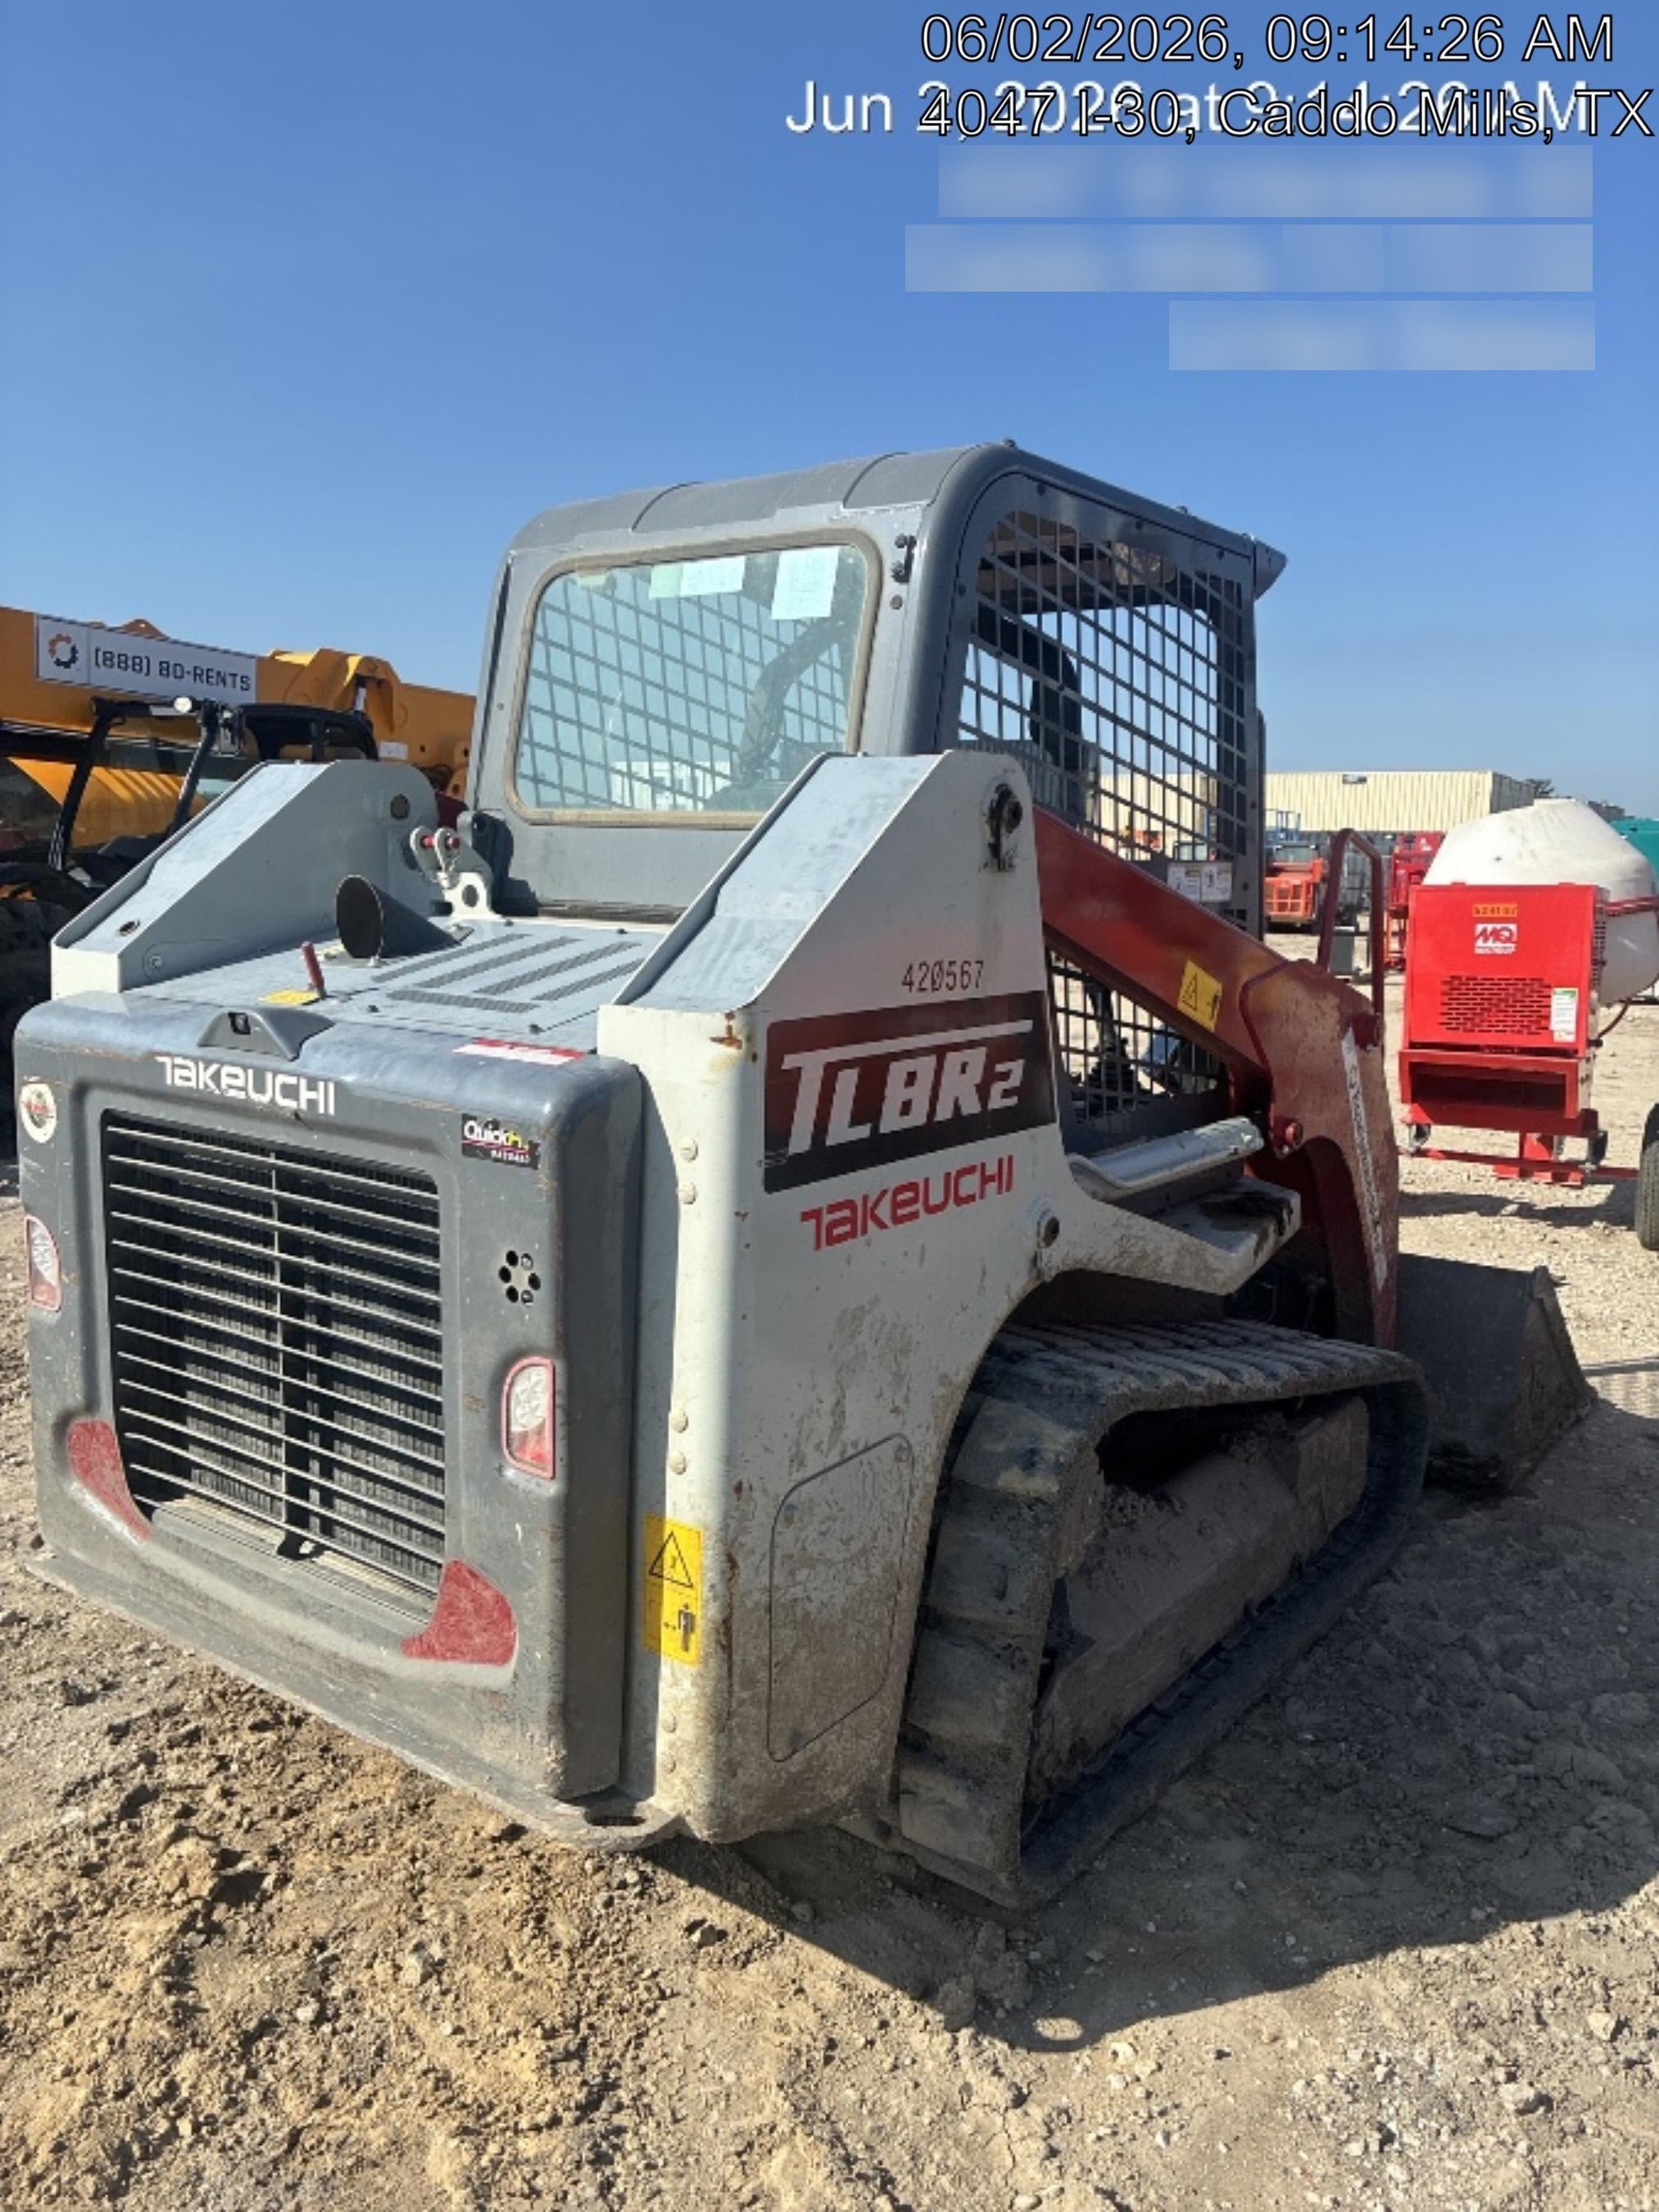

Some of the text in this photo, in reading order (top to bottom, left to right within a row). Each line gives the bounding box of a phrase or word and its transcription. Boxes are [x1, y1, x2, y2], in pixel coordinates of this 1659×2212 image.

[94, 647, 151, 677] (888)
[1475, 927, 1517, 944] MQ
[902, 959, 984, 993] 420567
